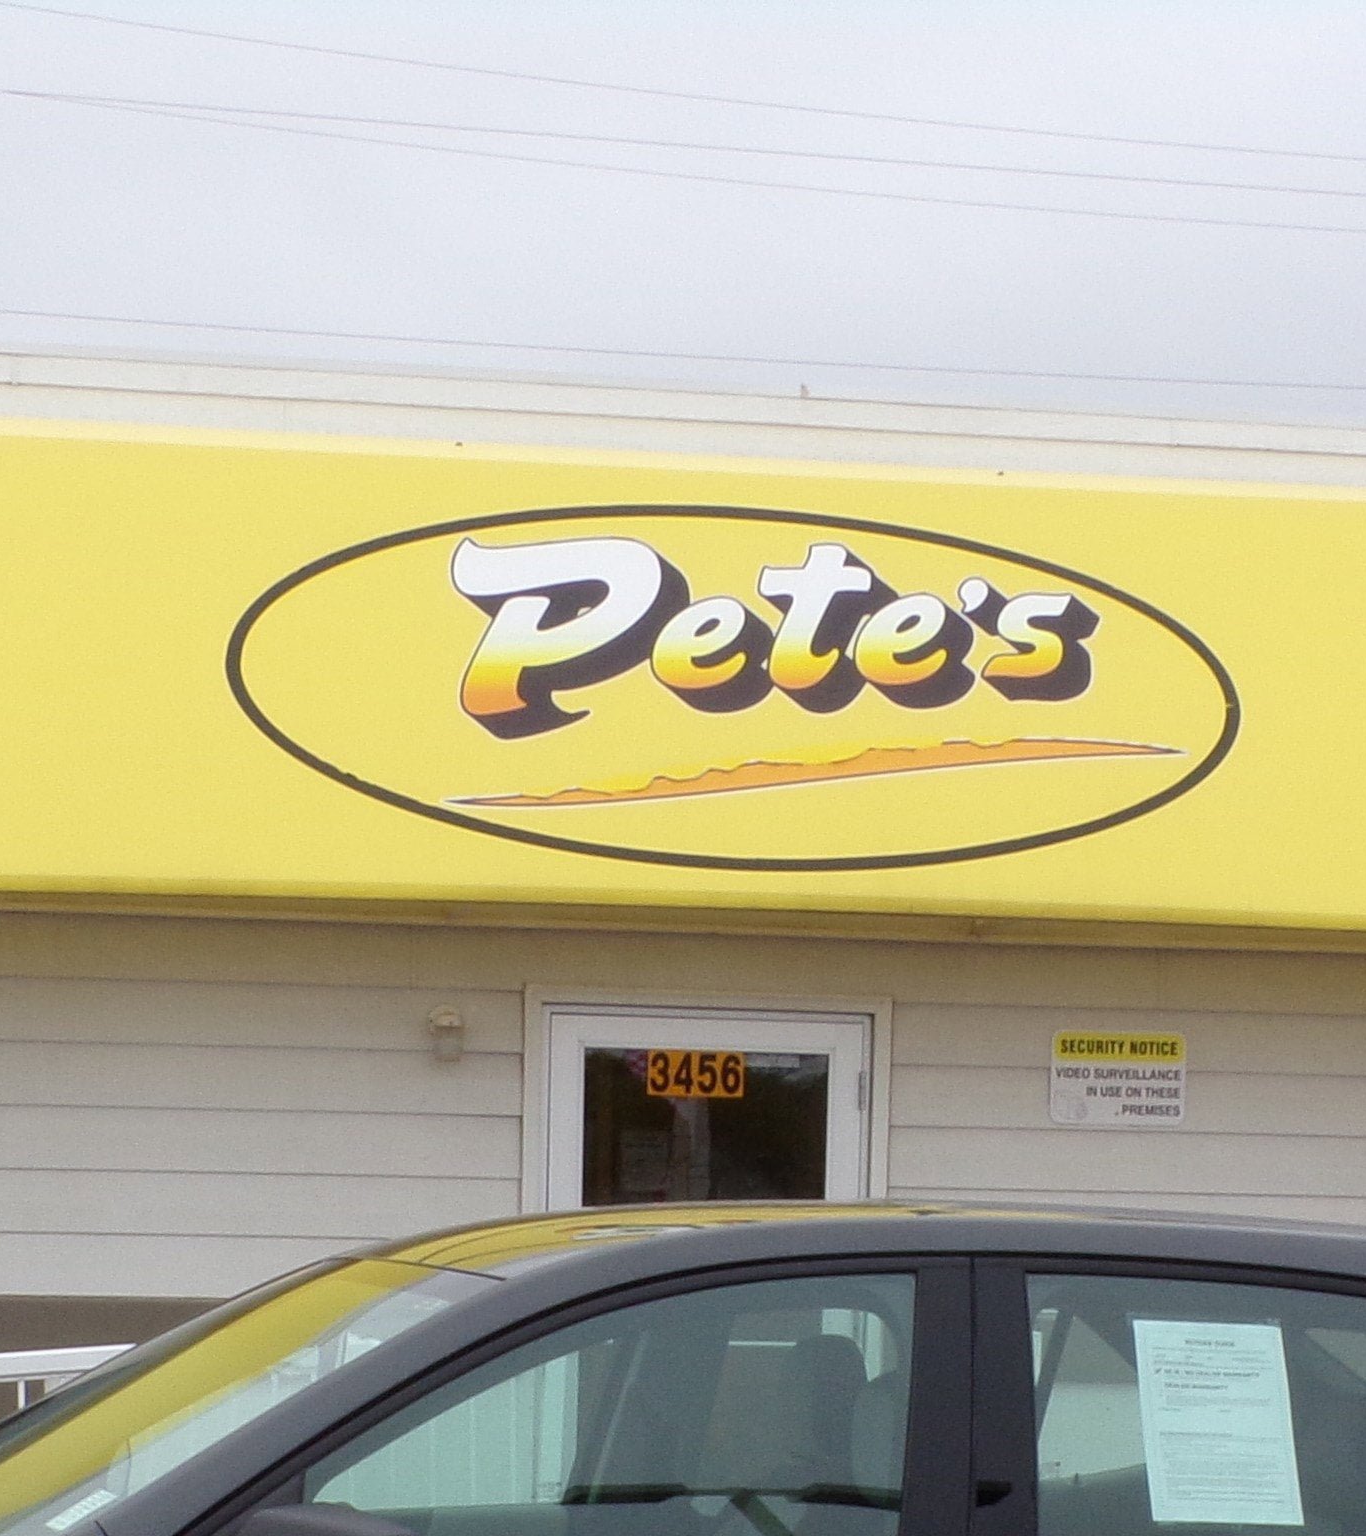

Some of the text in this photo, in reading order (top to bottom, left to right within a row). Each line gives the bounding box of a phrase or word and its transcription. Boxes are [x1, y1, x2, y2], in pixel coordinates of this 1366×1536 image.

[451, 536, 1101, 740] Pete's
[1060, 1039, 1179, 1056] SECURITY NOTICE
[650, 1052, 741, 1094] 3456
[1055, 1068, 1181, 1081] VIDEO SURVEILLANCE
[1086, 1086, 1181, 1099] IN USE ON THESE
